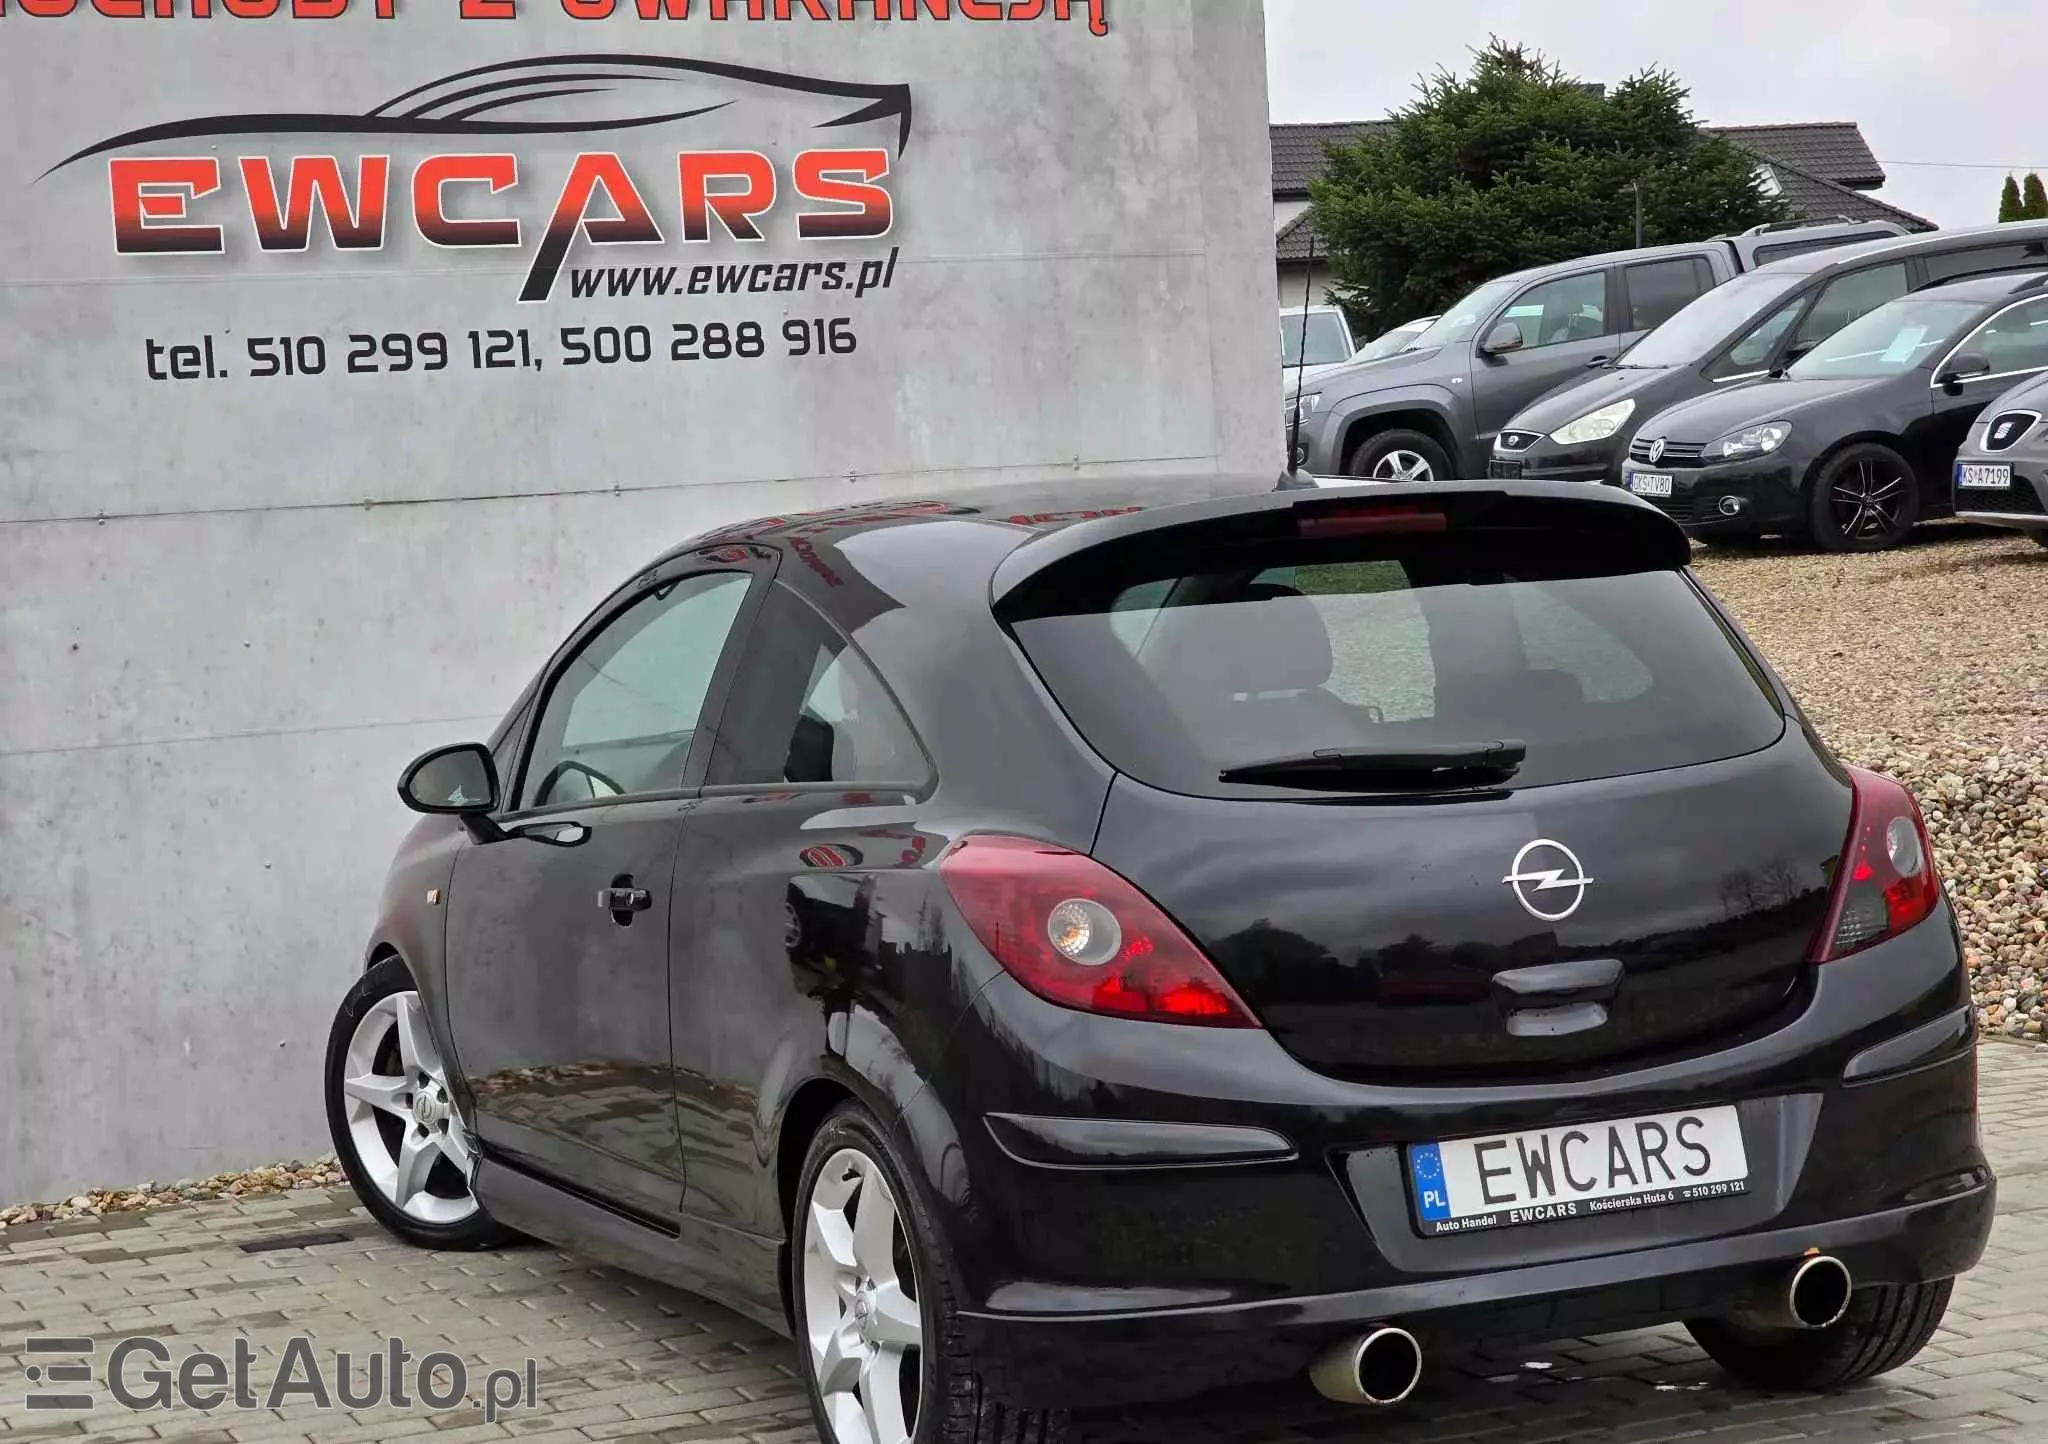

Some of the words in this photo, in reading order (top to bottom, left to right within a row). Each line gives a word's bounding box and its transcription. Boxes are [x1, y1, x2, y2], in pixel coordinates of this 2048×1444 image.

[109, 147, 893, 303] EWCARS
[571, 246, 899, 298] www.ewcars.pl
[146, 337, 228, 380] tel.
[248, 335, 326, 377] 510
[347, 331, 448, 372] 299
[471, 328, 542, 372] 121,
[562, 325, 651, 366] 500
[670, 321, 765, 361] 288
[781, 317, 857, 357] 916
[1474, 1116, 1711, 1206] EWCARS
[1423, 1190, 1447, 1209] PL
[1436, 1220, 1460, 1233] Auto
[1461, 1214, 1497, 1229] Handel
[1509, 1202, 1578, 1223] EWCARS
[1643, 1191, 1666, 1205] Huta
[1667, 1191, 1674, 1201] 6
[1692, 1187, 1709, 1198] 510
[1710, 1183, 1728, 1195] 299
[1729, 1180, 1745, 1192] 121
